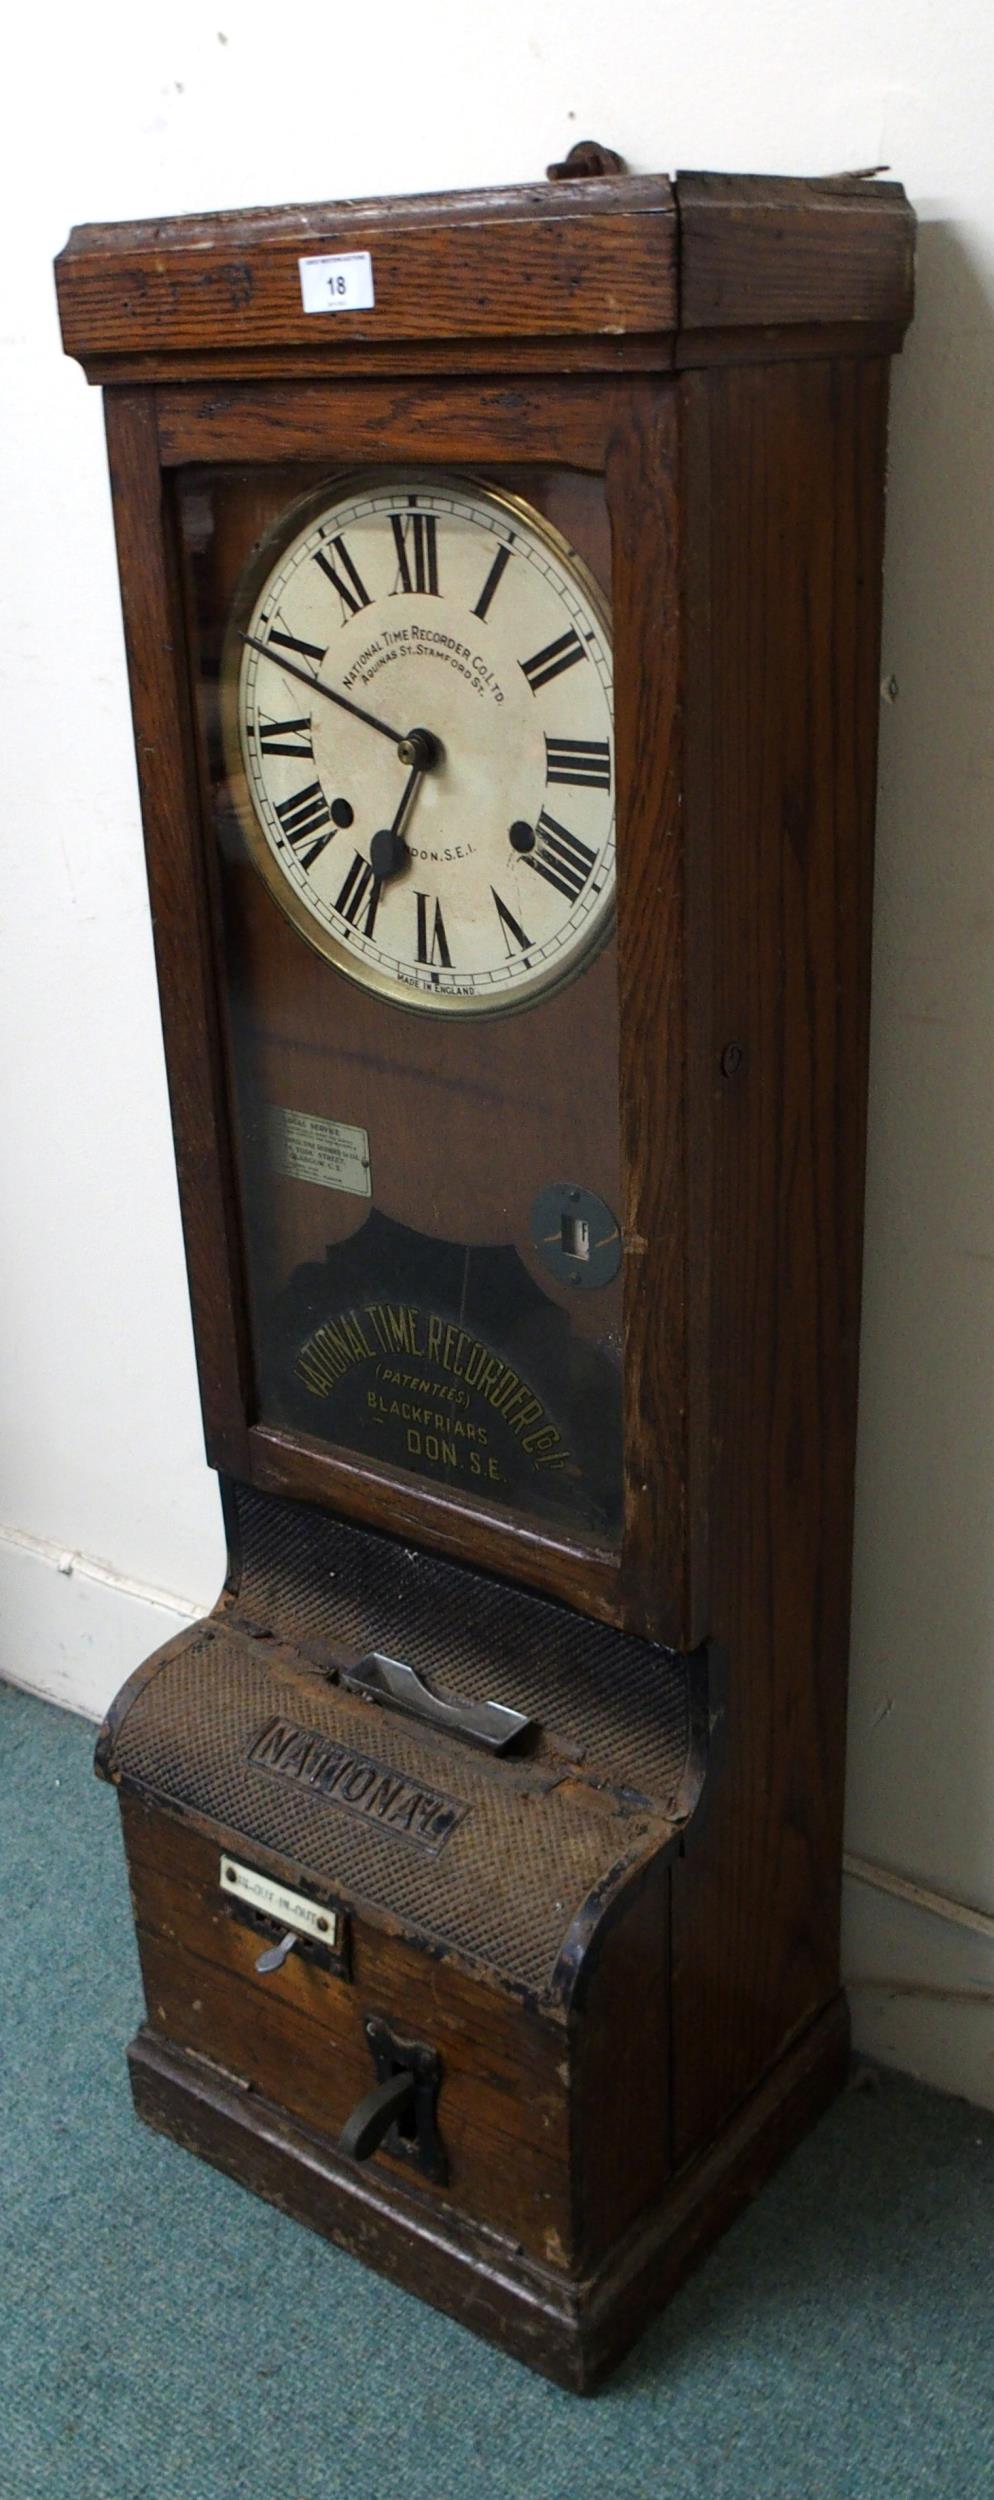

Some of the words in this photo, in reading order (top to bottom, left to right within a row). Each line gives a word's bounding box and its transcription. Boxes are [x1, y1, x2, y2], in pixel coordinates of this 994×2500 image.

[326, 275, 347, 297] 18
[342, 641, 383, 691] NATIONAL
[381, 629, 409, 647] TIME
[411, 625, 472, 661] RECORDER
[360, 649, 398, 686] AQUINAS
[397, 973, 419, 988] MADE
[422, 981, 432, 992] IN
[434, 984, 475, 996] ENGLAND
[365, 1304, 425, 1357] TIME
[427, 1313, 545, 1434] RECORDER
[367, 1391, 489, 1445] BLACKFRIARS
[258, 1725, 444, 1842] NATIONAL
